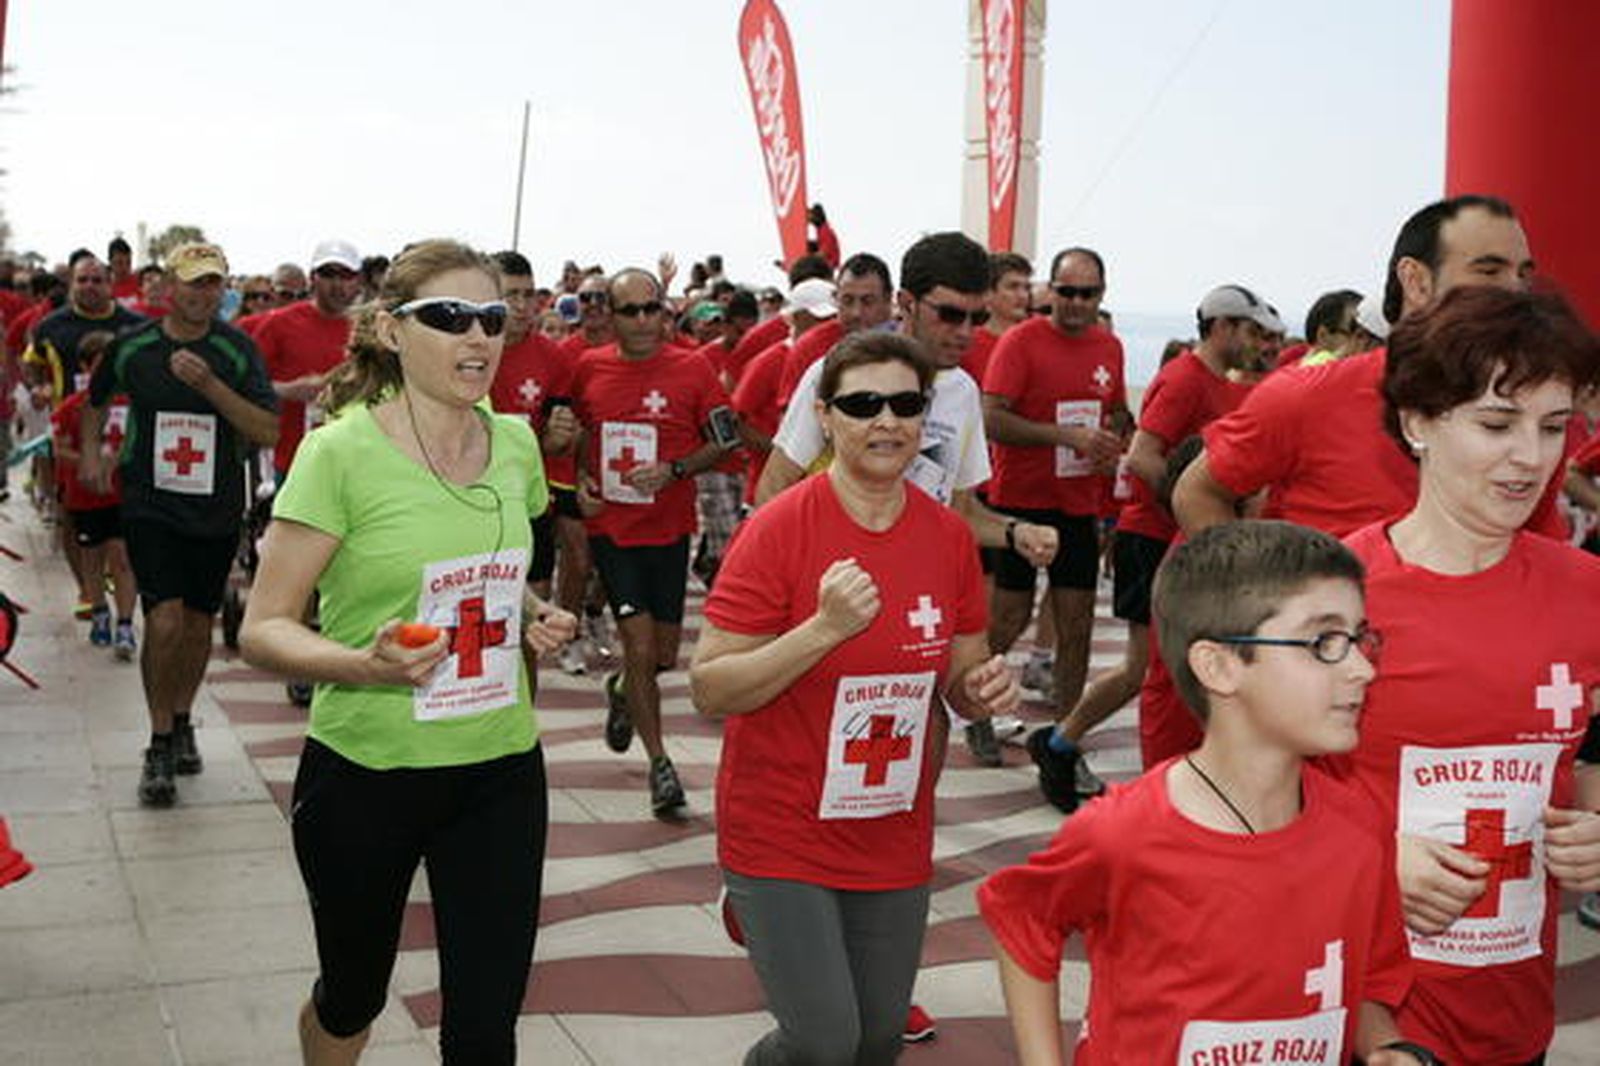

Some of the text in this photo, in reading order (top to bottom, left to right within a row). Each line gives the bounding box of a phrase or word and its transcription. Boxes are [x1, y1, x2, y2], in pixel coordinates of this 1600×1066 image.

[430, 563, 519, 593] CRUZ ROJA
[845, 684, 887, 704] CRUZ
[1414, 759, 1543, 787] CRUZ ROJA
[1191, 1037, 1328, 1066] CRUZ ROJA
